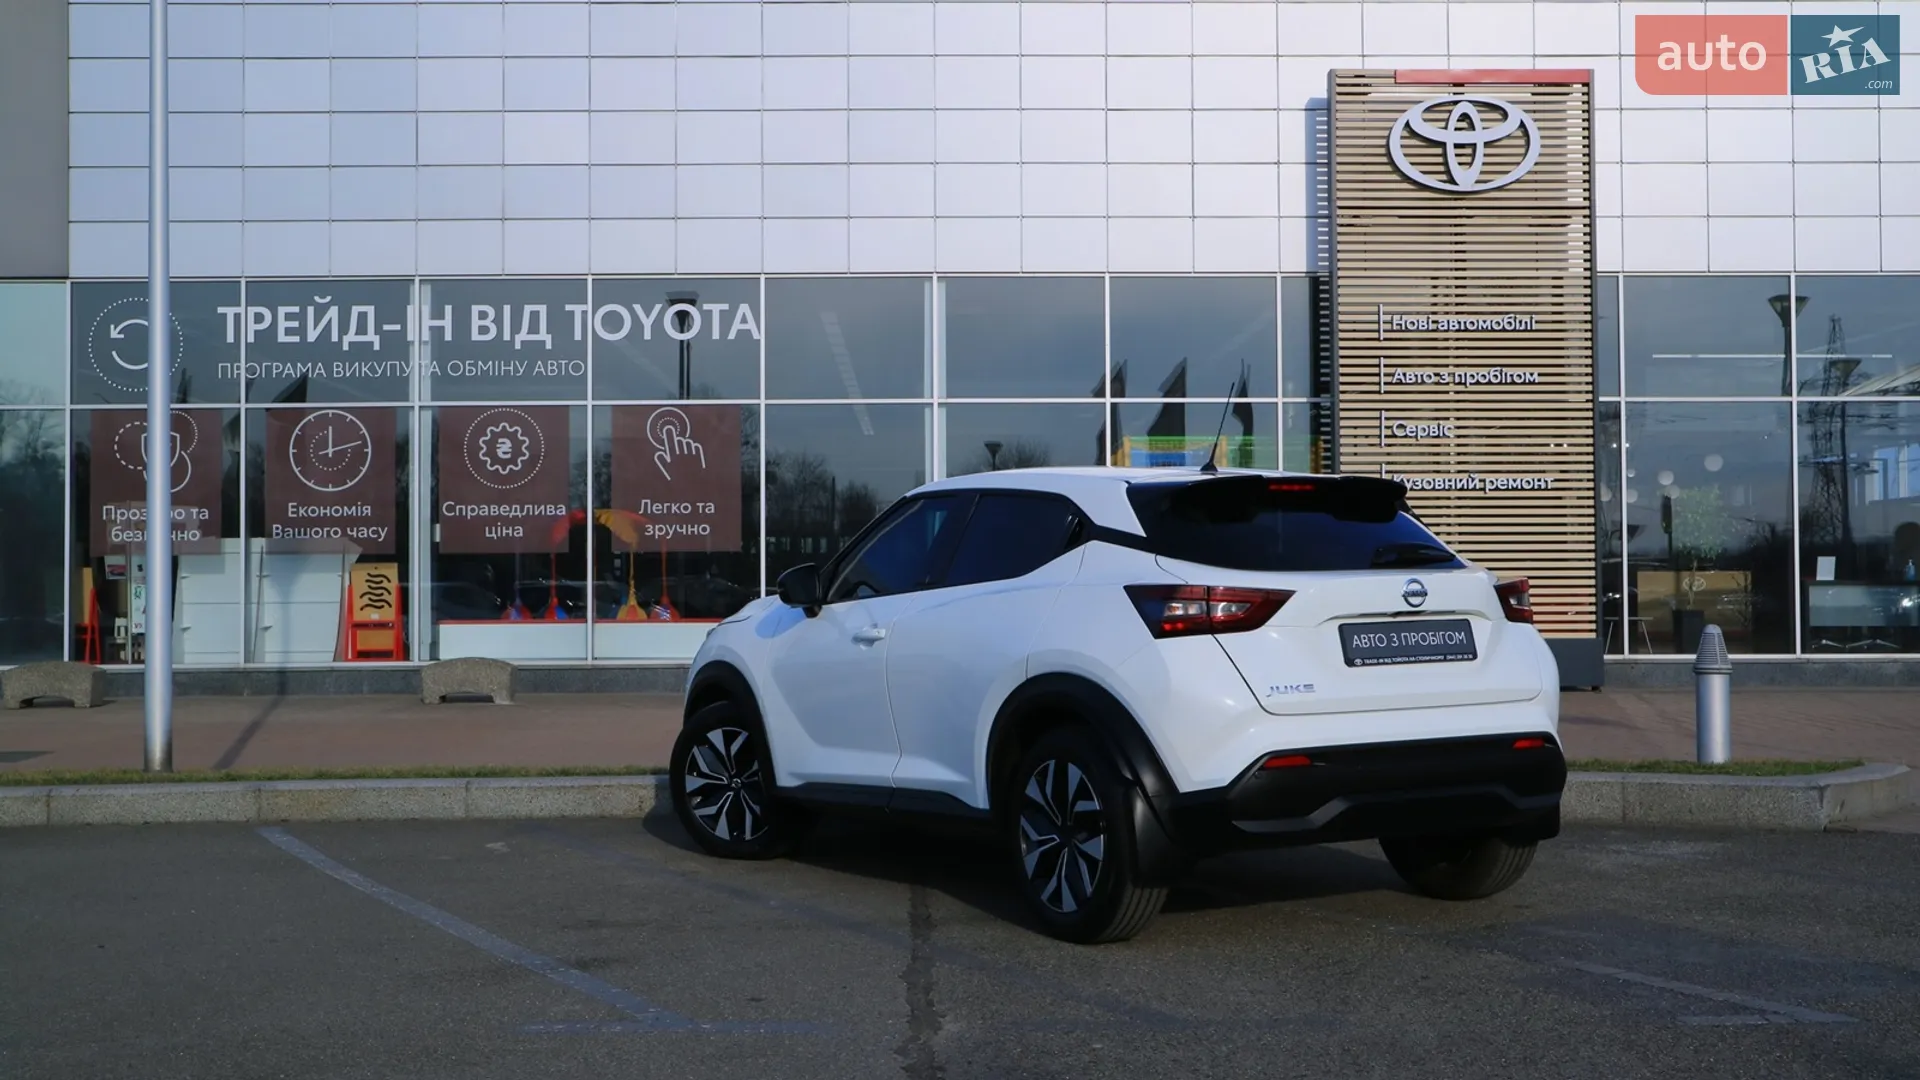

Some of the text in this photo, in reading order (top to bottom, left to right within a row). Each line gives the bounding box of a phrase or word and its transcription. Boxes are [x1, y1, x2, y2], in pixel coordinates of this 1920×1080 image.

[217, 296, 761, 350] ТРЕЙД-ІН ВІД TOYOTA
[1392, 314, 1536, 331] Нові автомобілі
[218, 359, 585, 379] ПРОГРАМА ВИКУПУ ТА ОБМІНУ АВТО
[1392, 368, 1539, 388] Авто з пробігом
[1392, 421, 1455, 441] Сервіс
[1485, 478, 1555, 494] ремонт
[103, 505, 209, 524] Прозо та
[287, 502, 372, 518] Економія
[442, 502, 566, 519] Справедлива
[639, 499, 716, 517] Легко та
[111, 526, 200, 542] безчно
[272, 525, 388, 543] Вашого часу
[485, 523, 524, 538] ціна
[645, 522, 710, 540] зручно
[1352, 634, 1387, 648] АВТО
[1401, 631, 1467, 646] ПРОБІГОМ
[1266, 684, 1316, 697] JUKE
